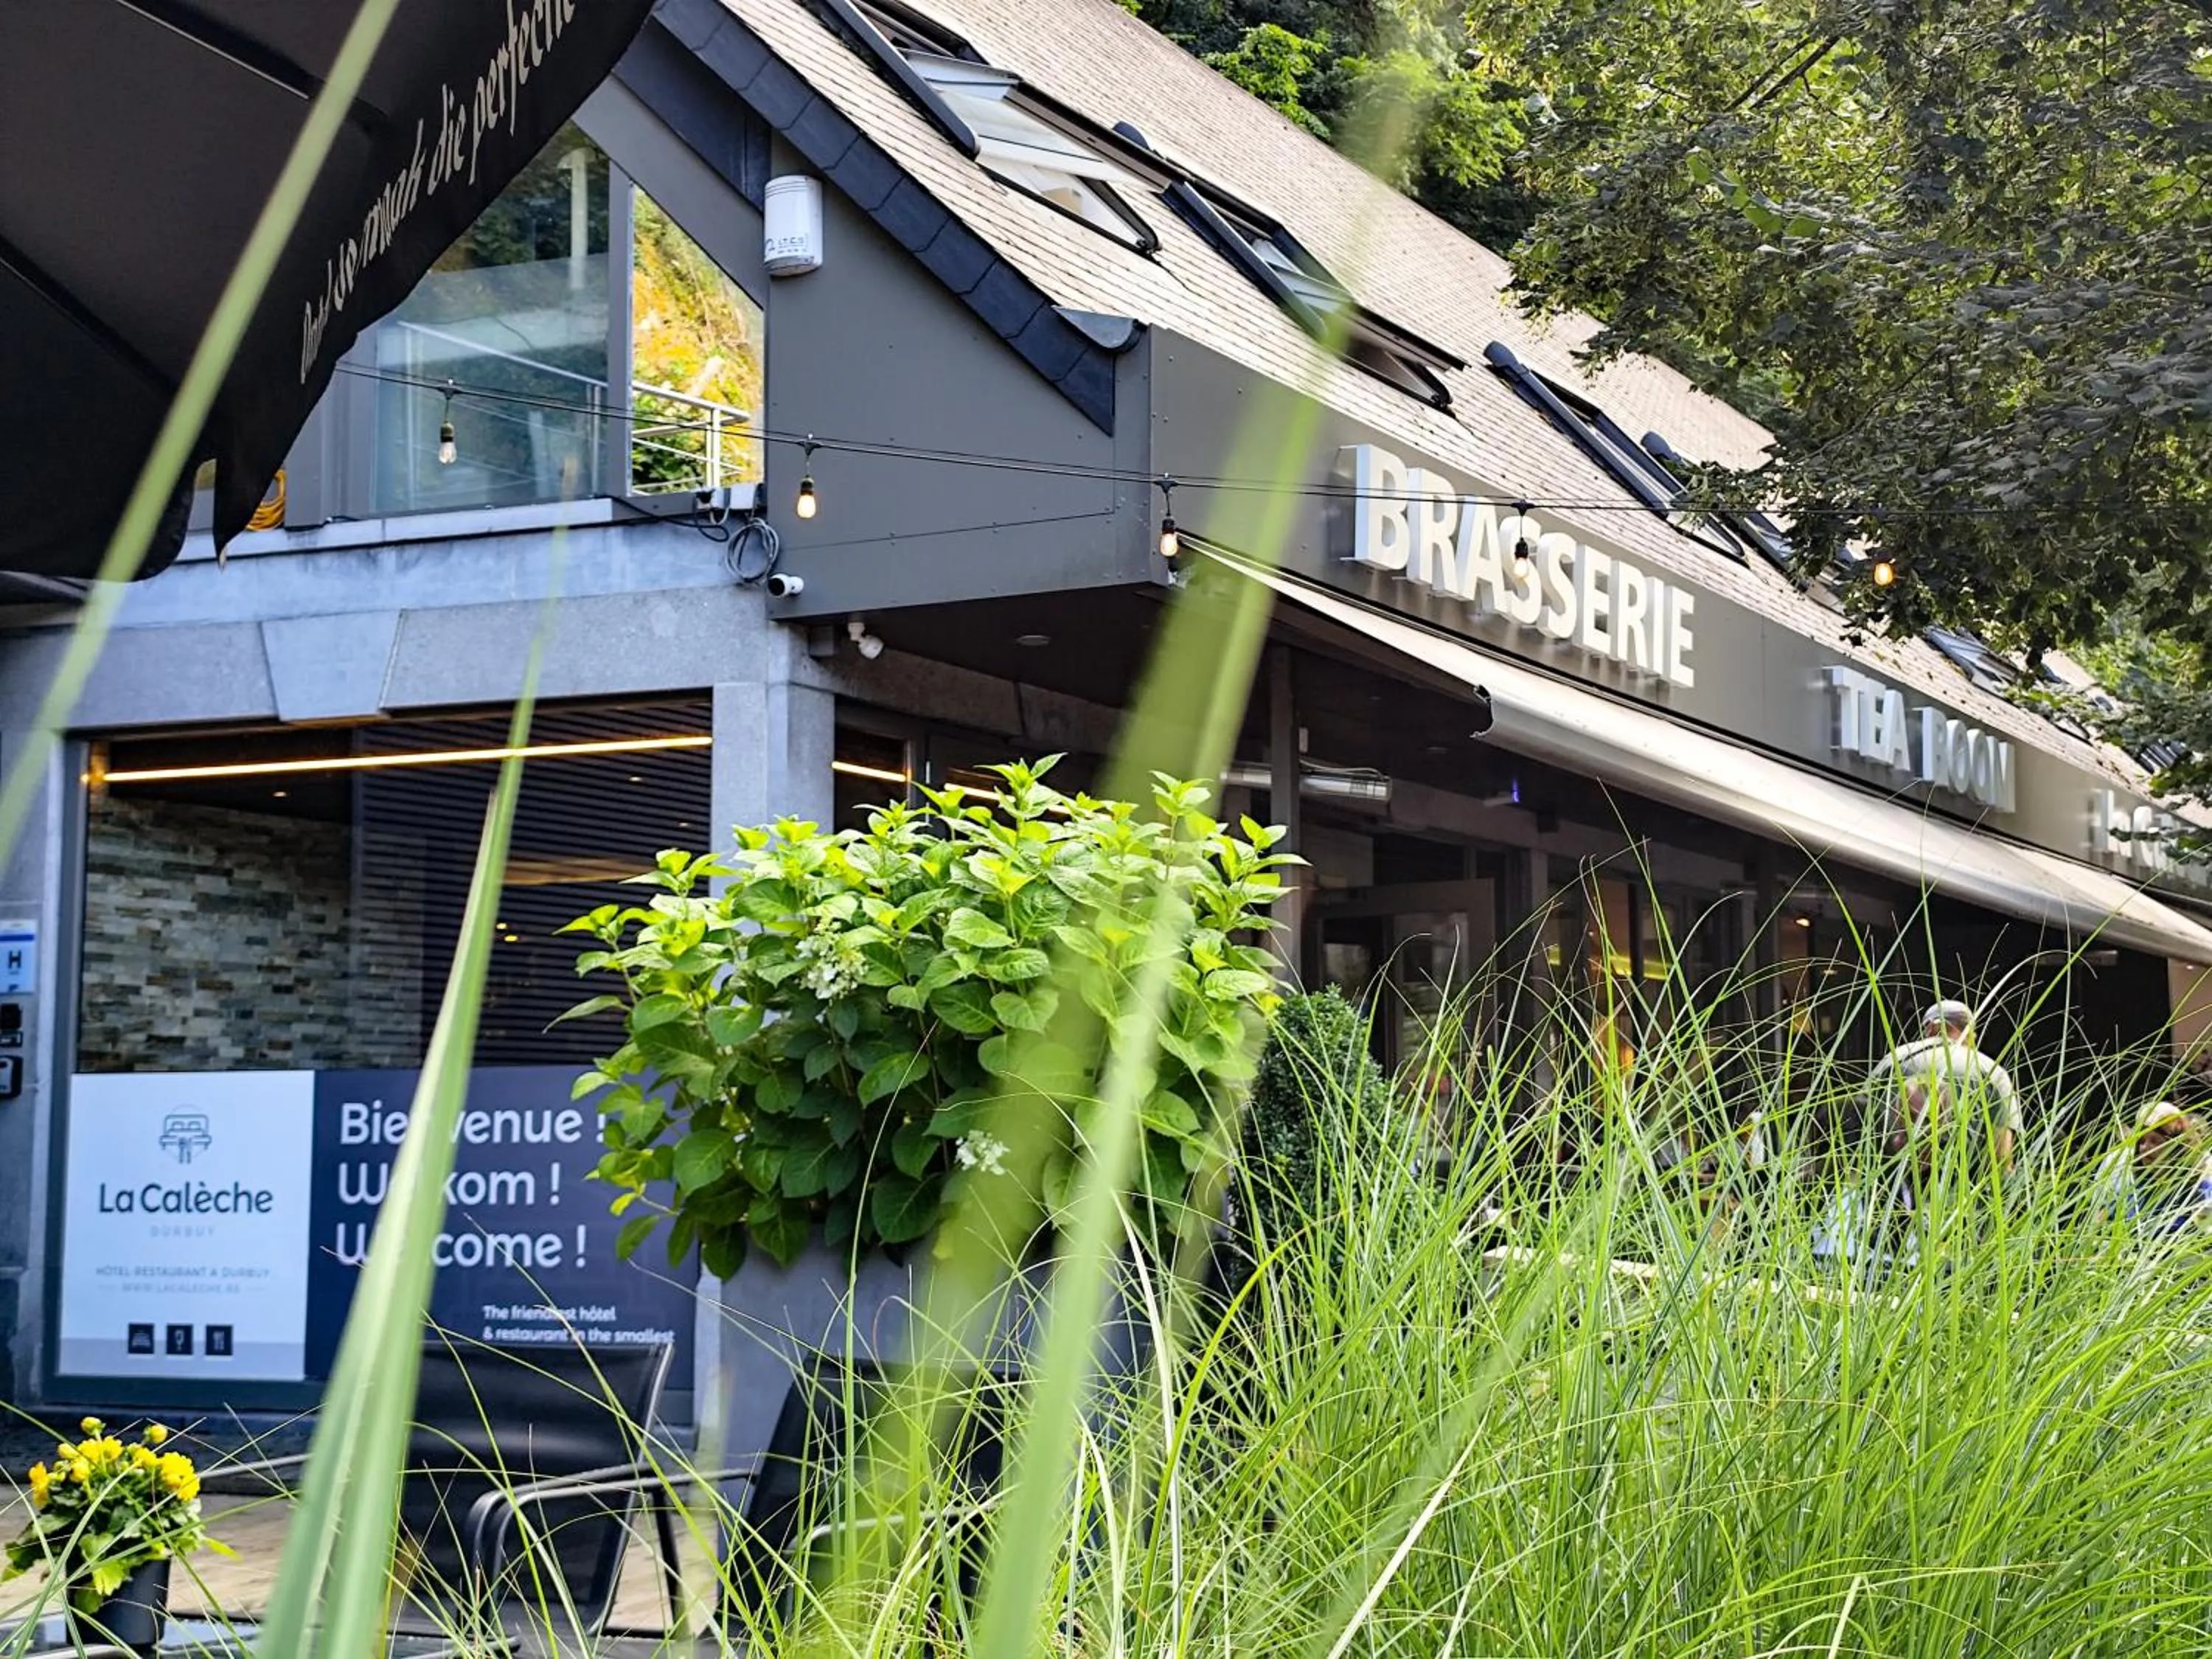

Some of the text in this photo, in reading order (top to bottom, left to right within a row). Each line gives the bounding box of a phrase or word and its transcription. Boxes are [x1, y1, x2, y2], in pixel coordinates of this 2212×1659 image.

[427, 83, 467, 196] die
[1354, 443, 1694, 688] BRASSERIE
[1832, 664, 2015, 813] TEA ROOM
[341, 1099, 583, 1144] Bievenue
[100, 1180, 274, 1214] La Calèche
[338, 1162, 561, 1206] Wkom !
[335, 1222, 587, 1269] Wcome !
[483, 1304, 509, 1321] The
[510, 1304, 577, 1321] friendst
[495, 1327, 568, 1342] restaurant
[588, 1326, 612, 1342] the
[613, 1328, 675, 1343] smallest
